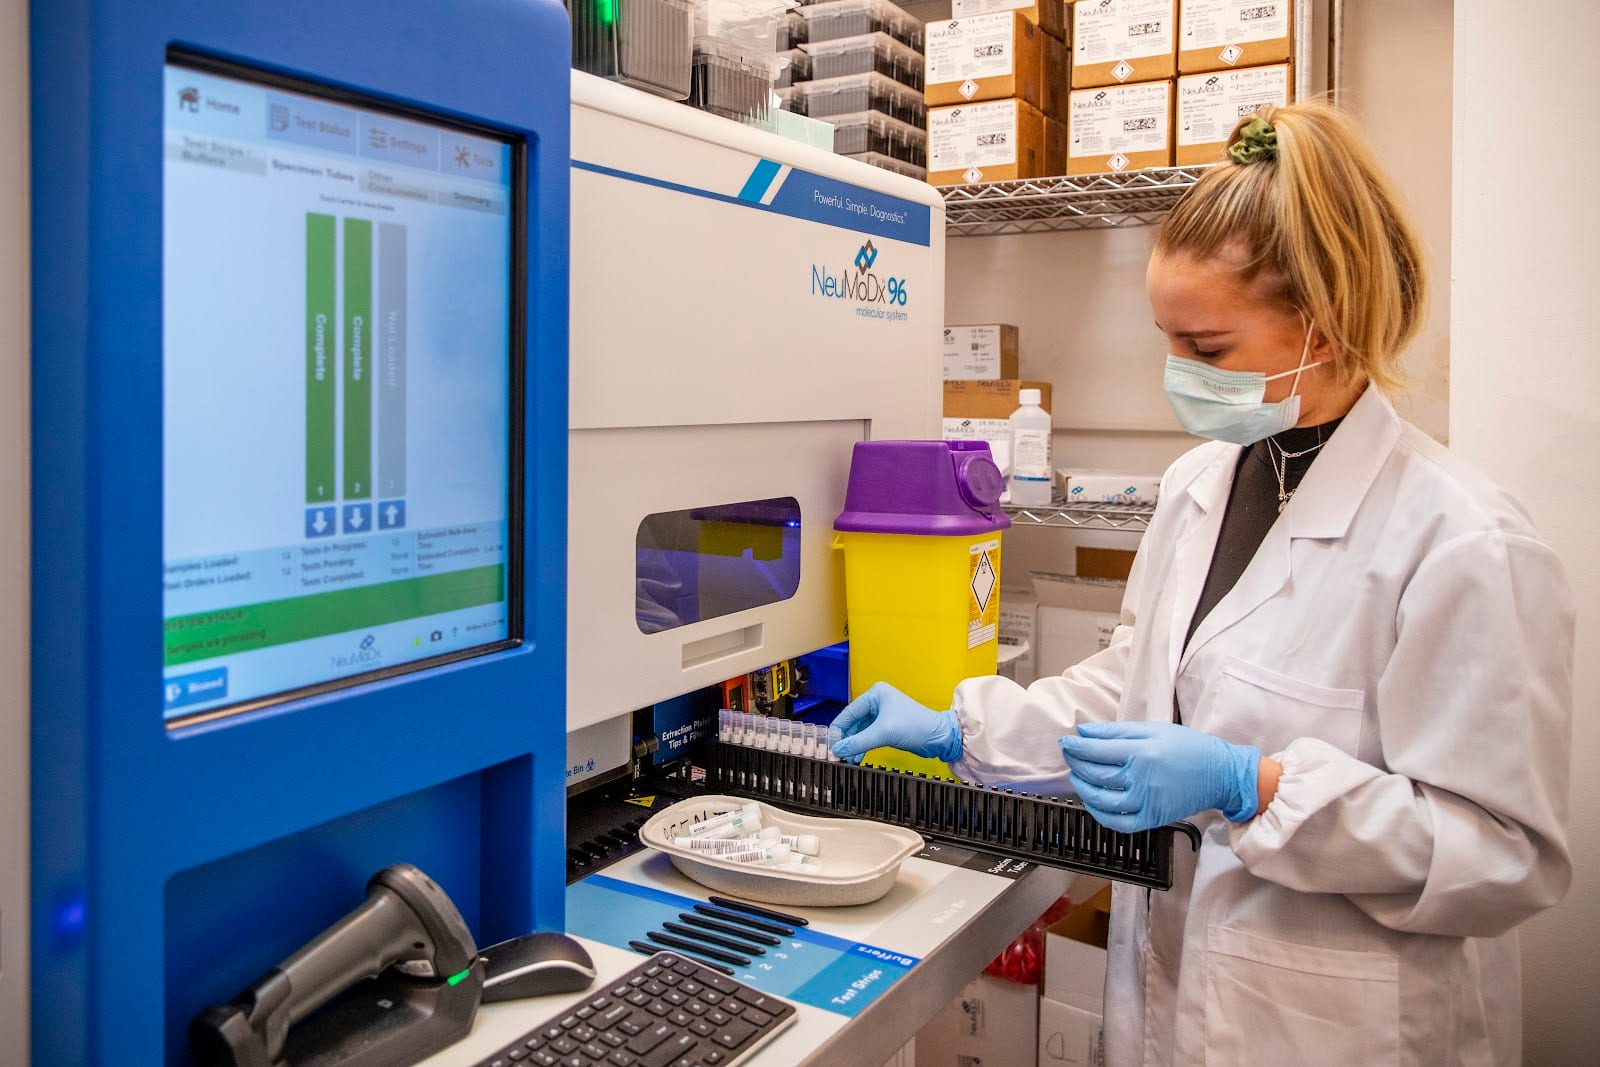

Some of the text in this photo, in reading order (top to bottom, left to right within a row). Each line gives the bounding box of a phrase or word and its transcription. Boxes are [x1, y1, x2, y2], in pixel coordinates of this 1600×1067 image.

[1182, 84, 1224, 96] NeuMoDx
[206, 97, 241, 116] Home
[294, 115, 351, 138] Test Status
[473, 152, 495, 168] Tools
[272, 159, 355, 182] Specimen Tubes
[454, 191, 491, 207] Summary
[814, 189, 845, 209] Powerful.
[845, 198, 869, 217] Simple.
[887, 277, 908, 306] 96
[856, 306, 908, 321] molecular system
[314, 313, 327, 381] Complete
[352, 316, 363, 381] Complete
[662, 724, 692, 741] Extraction
[668, 737, 682, 750] Tips
[683, 736, 689, 744] &
[573, 763, 584, 776] Bin
[775, 952, 788, 960] 3
[857, 946, 913, 967] Buffers
[759, 963, 773, 971] 2
[832, 968, 883, 1006] Test Strips
